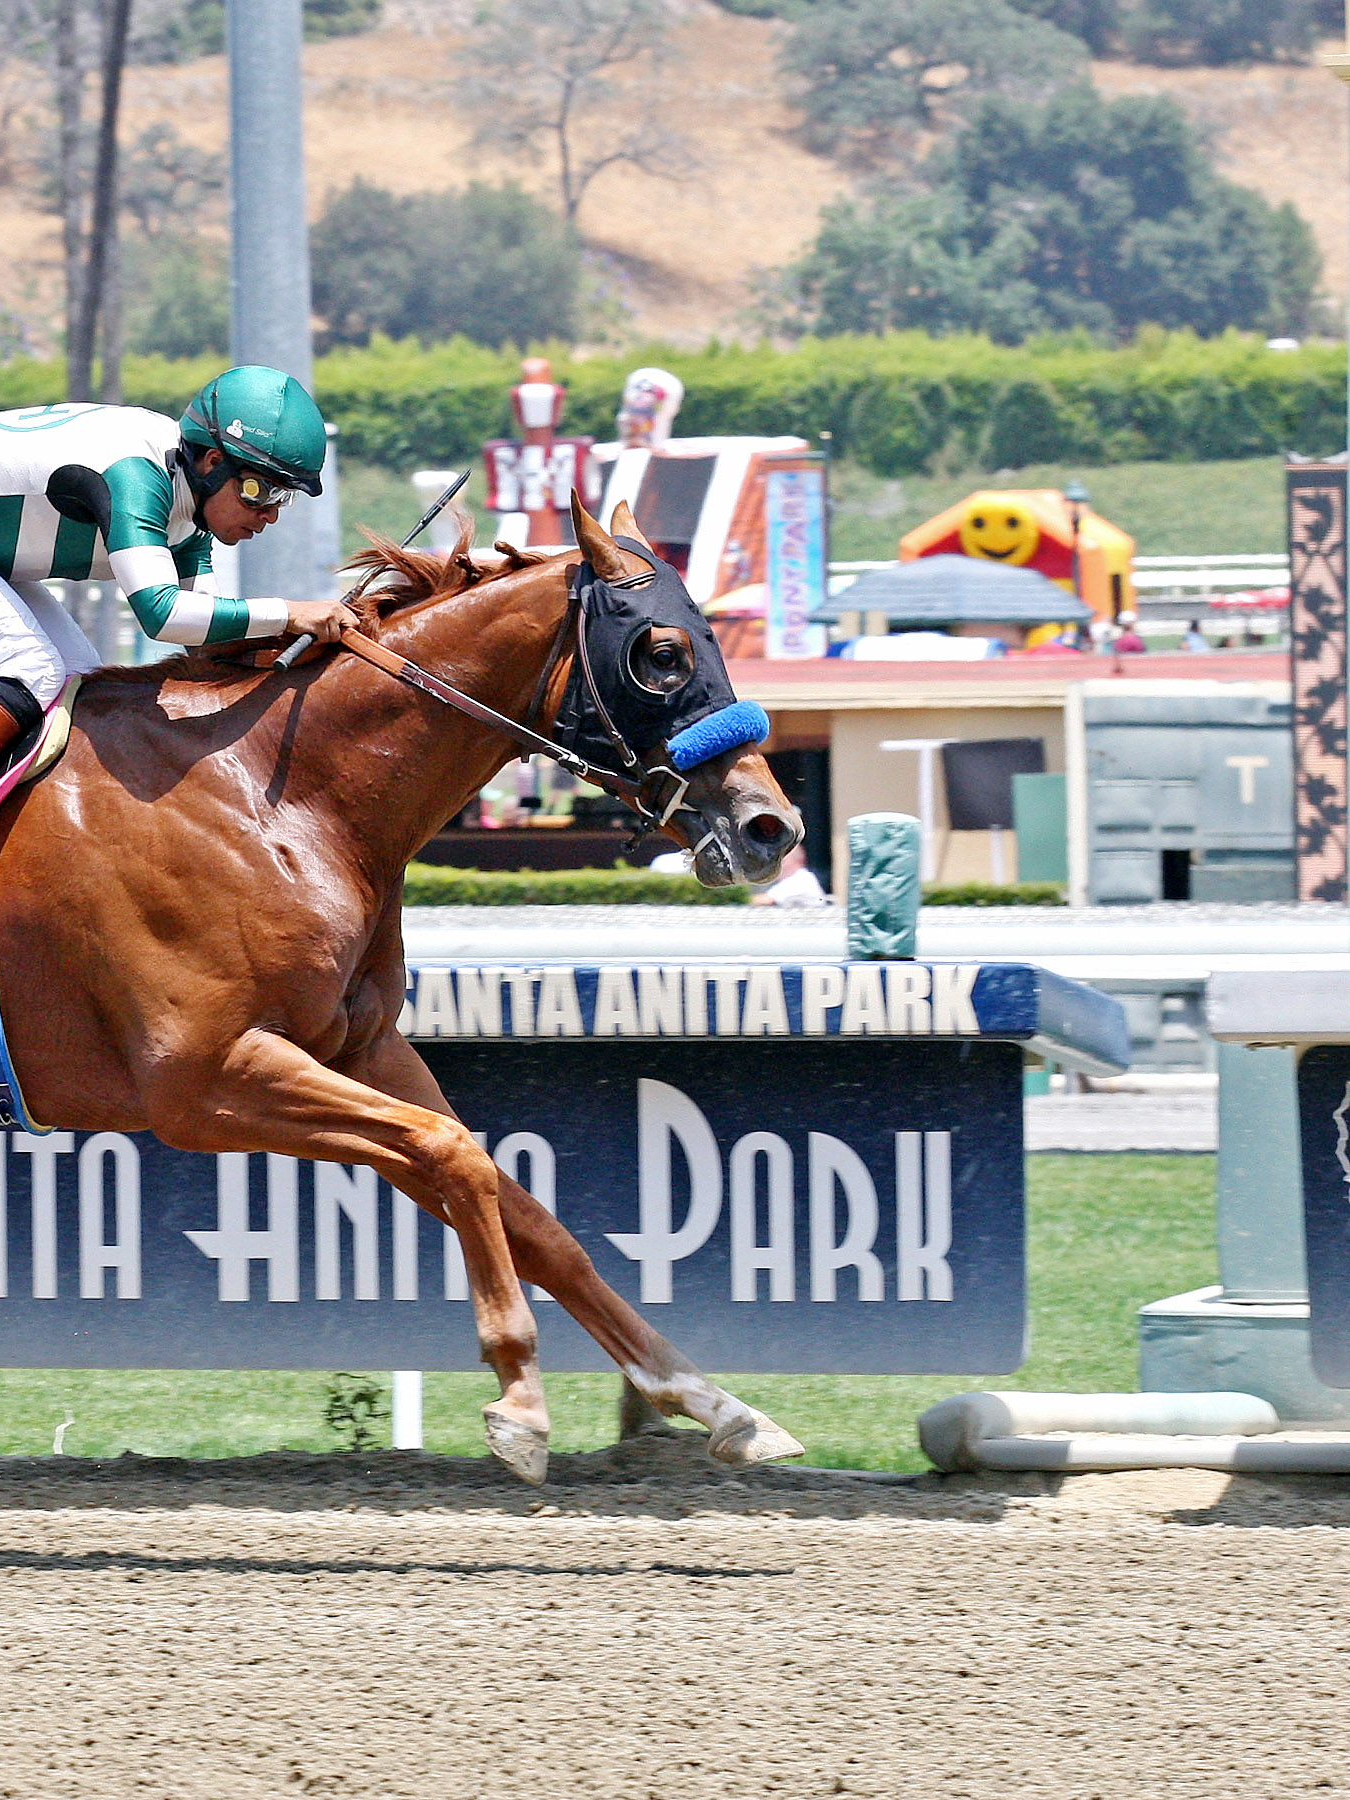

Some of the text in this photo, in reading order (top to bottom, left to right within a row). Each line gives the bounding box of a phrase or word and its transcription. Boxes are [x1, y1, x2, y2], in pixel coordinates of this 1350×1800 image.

[780, 565, 808, 653] PONY
[1224, 755, 1270, 804] T
[594, 965, 790, 1036] ANITA
[802, 964, 982, 1036] PARK
[603, 1077, 953, 1303] PARK
